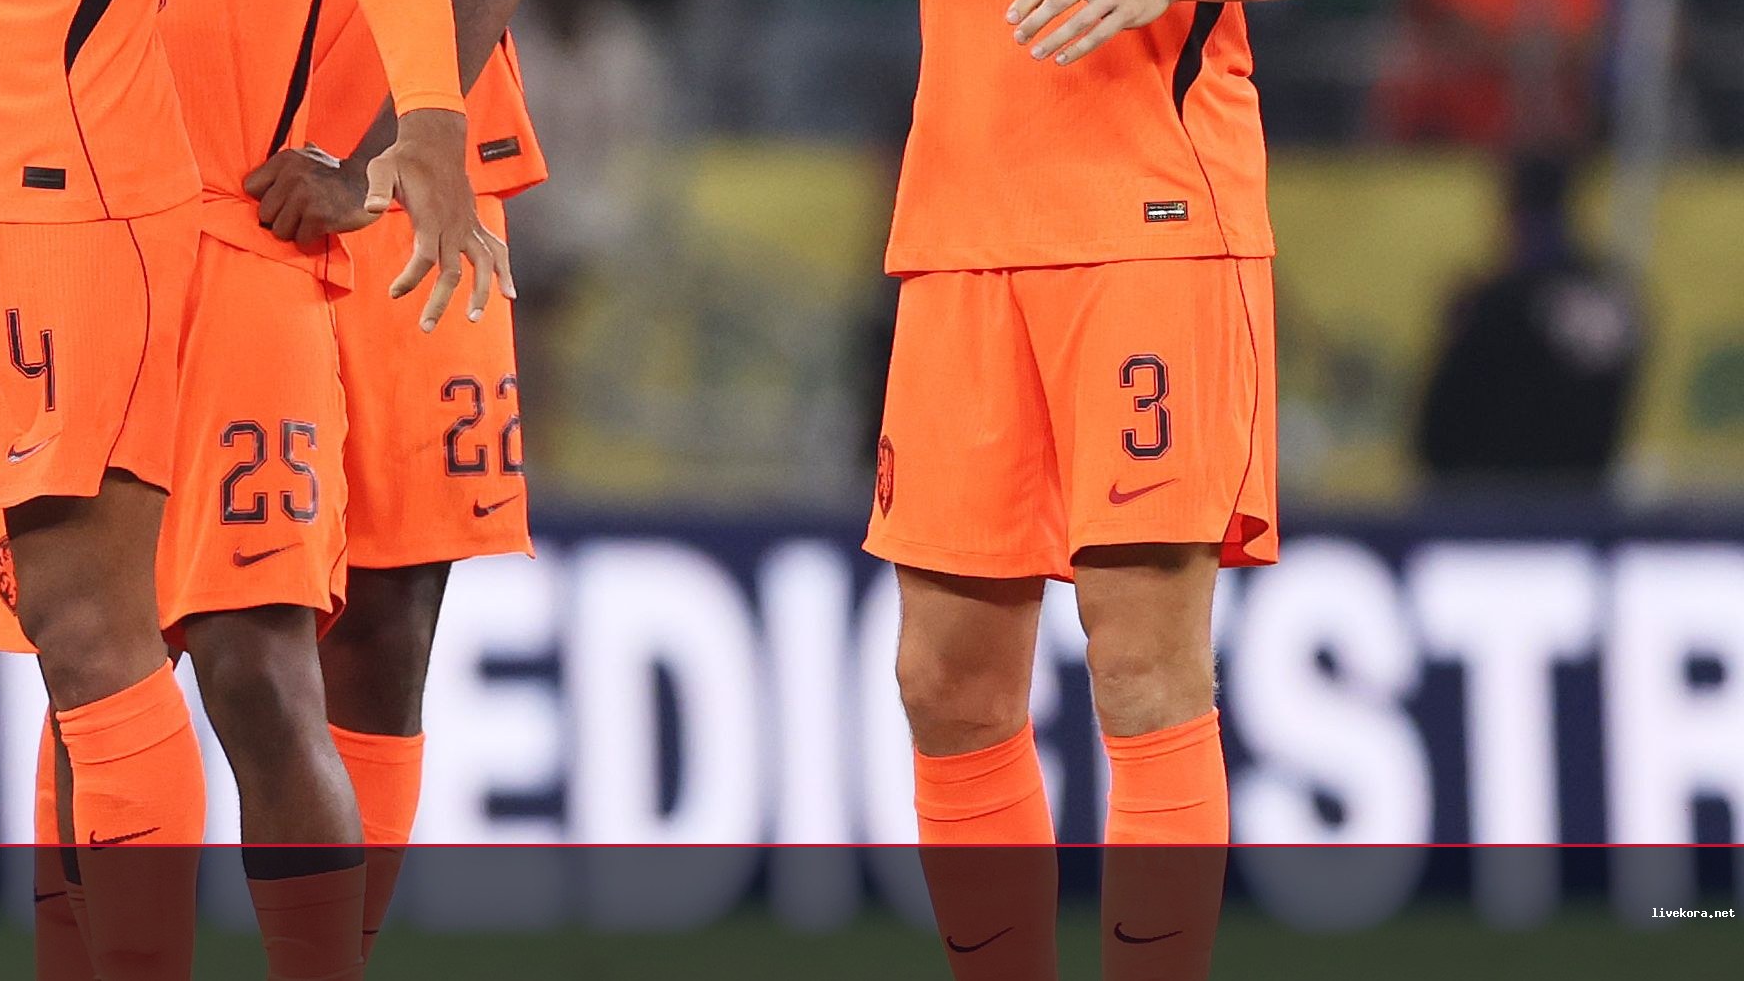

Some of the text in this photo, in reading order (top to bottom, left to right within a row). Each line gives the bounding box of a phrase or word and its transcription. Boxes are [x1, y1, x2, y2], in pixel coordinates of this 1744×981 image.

[6, 308, 55, 412] 4
[1119, 354, 1171, 461] 3
[219, 419, 319, 525] 25
[441, 373, 525, 477] 22
